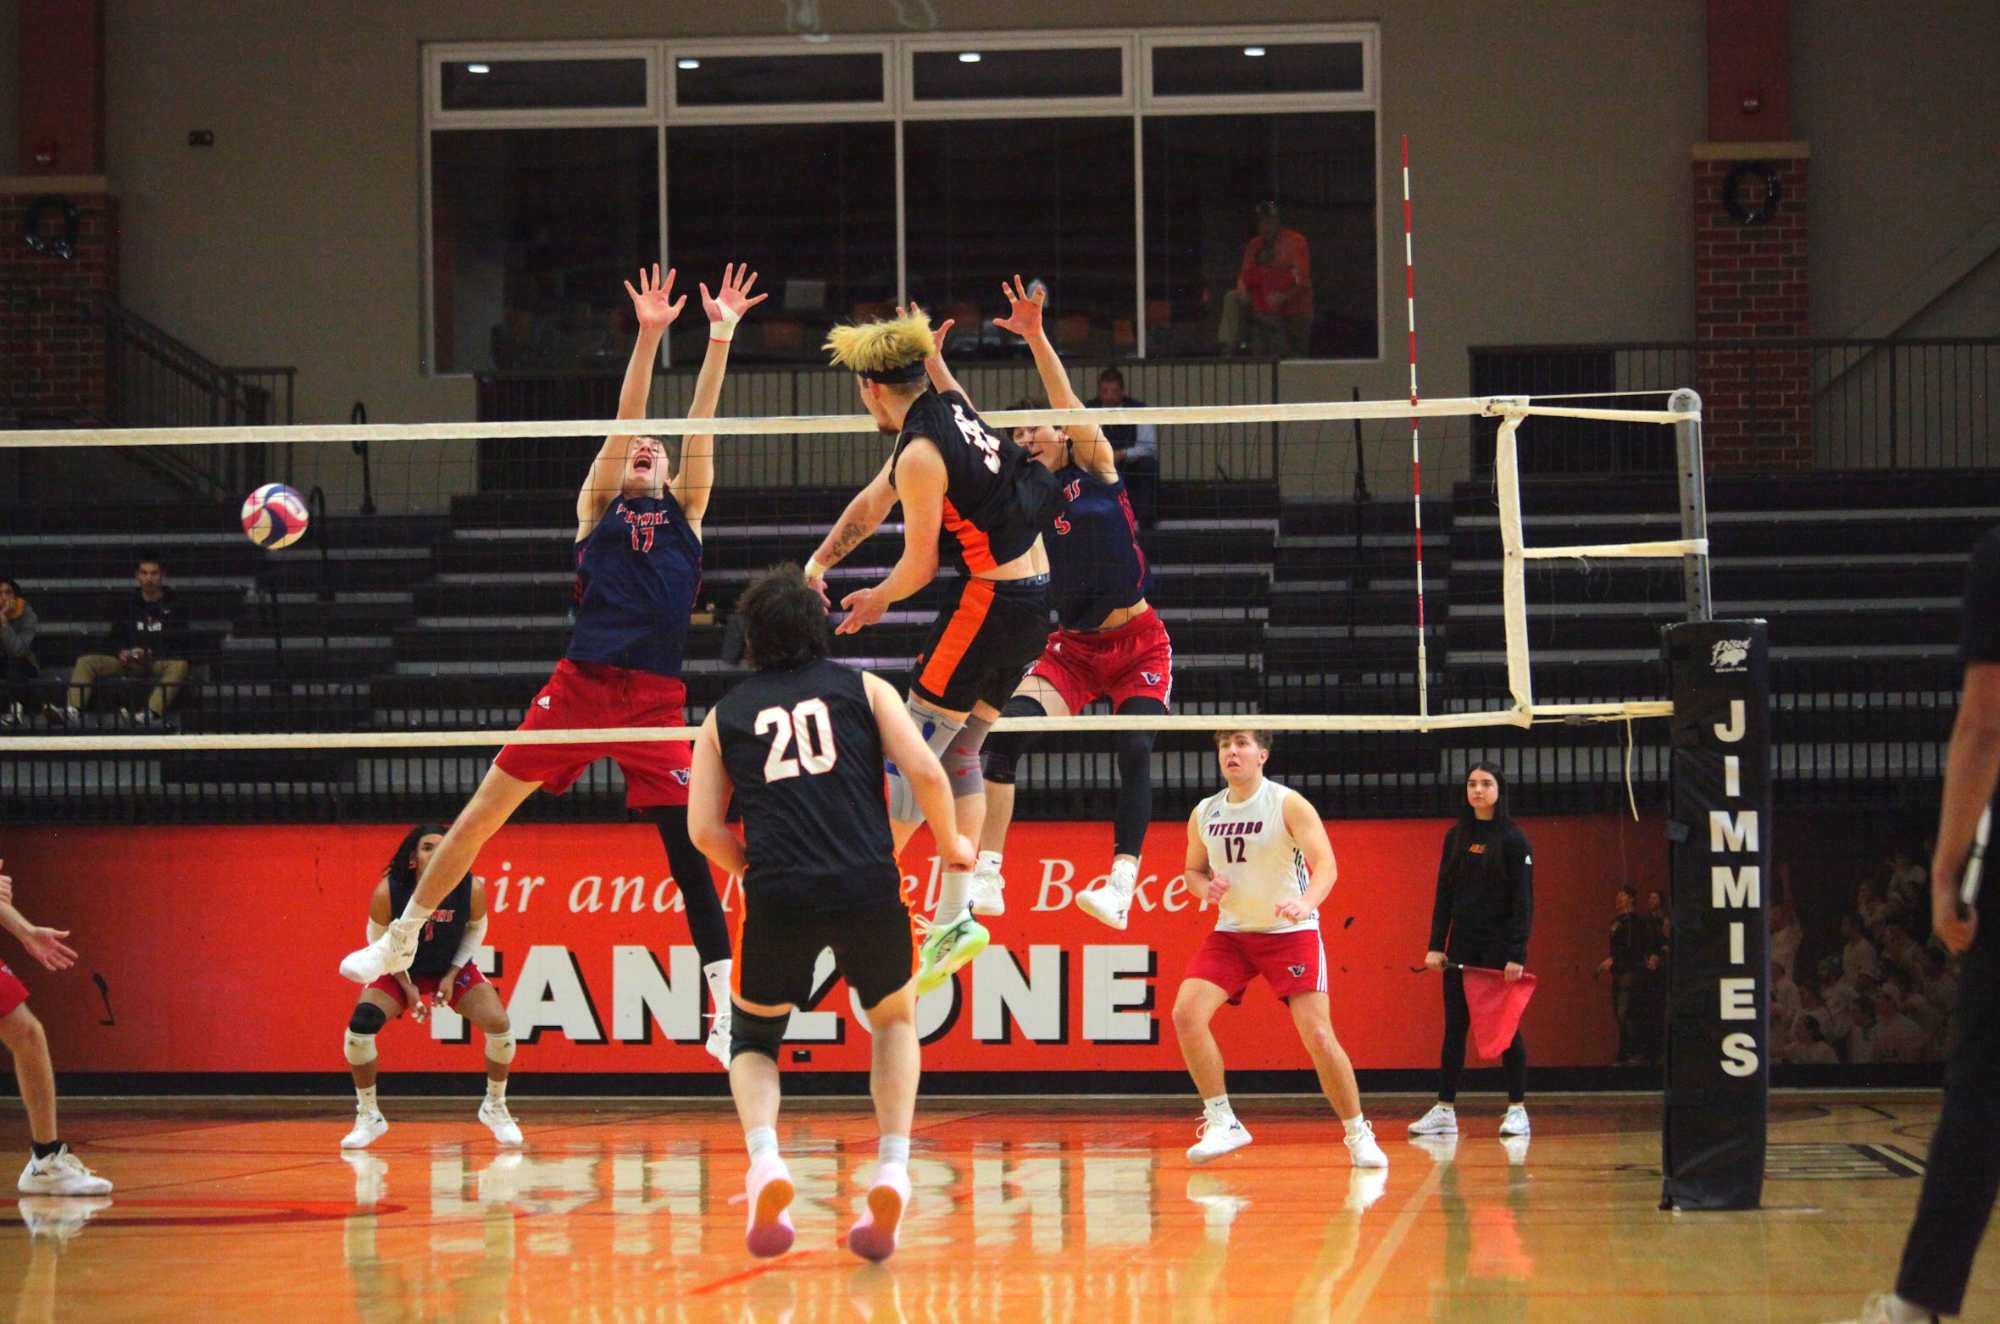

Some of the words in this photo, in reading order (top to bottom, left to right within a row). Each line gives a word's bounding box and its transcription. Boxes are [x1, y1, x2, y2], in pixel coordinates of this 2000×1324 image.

[1054, 511, 1071, 535] 5
[631, 524, 655, 553] 17
[754, 697, 837, 784] 20
[1208, 820, 1264, 837] VITERBO
[1224, 836, 1248, 864] 12
[1030, 854, 1210, 913] Bke
[1709, 699, 1760, 1077] JIMMIES
